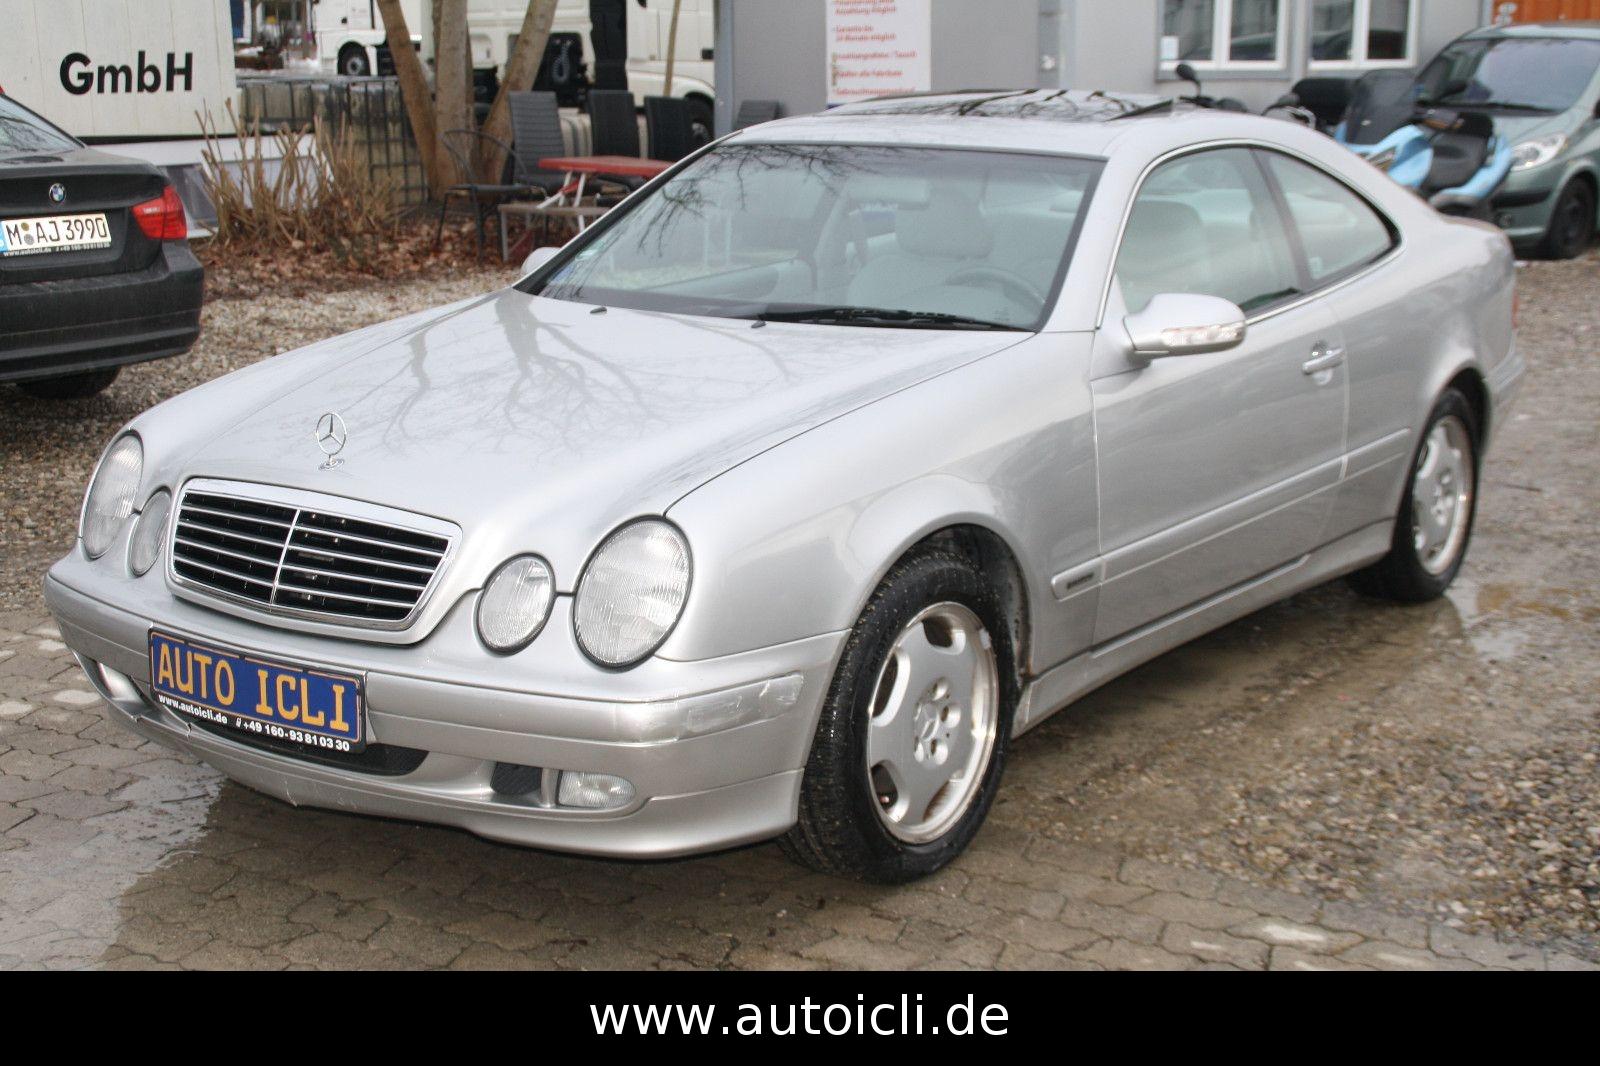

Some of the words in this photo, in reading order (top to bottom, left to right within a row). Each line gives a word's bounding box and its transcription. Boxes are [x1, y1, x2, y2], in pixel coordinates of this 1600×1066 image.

[59, 50, 193, 96] GmbH
[6, 223, 22, 246] M
[36, 221, 61, 243] AJ
[62, 217, 107, 240] 3990
[158, 643, 235, 706] AUTO
[255, 669, 350, 732] ICLI
[158, 694, 228, 724] www.autoicli.de
[243, 720, 262, 733] +49
[335, 740, 350, 752] 30
